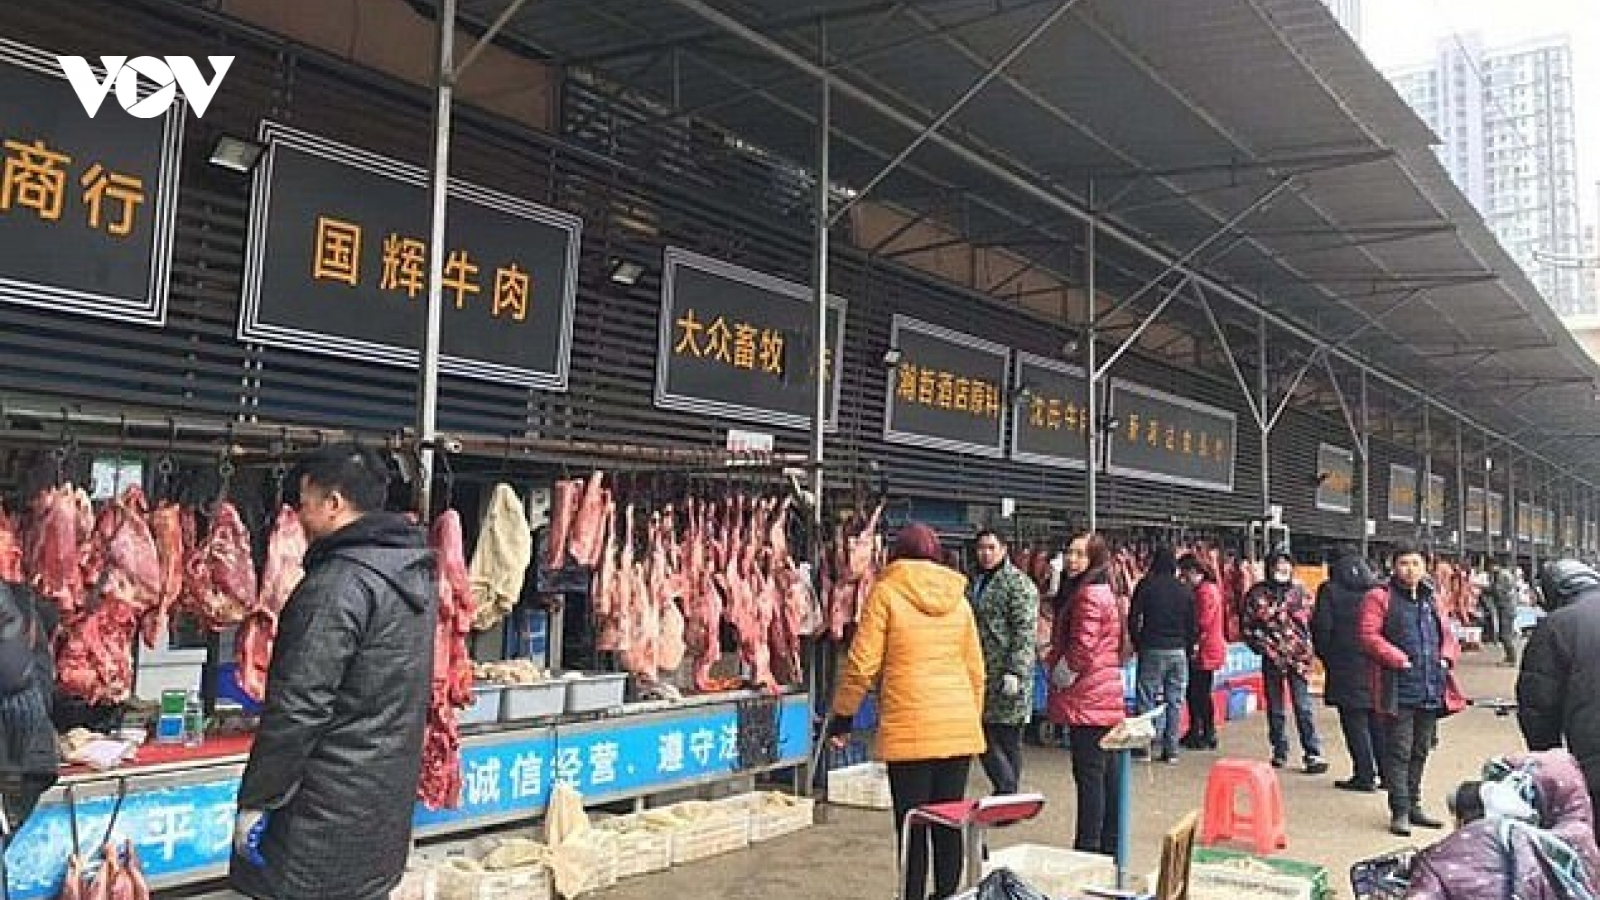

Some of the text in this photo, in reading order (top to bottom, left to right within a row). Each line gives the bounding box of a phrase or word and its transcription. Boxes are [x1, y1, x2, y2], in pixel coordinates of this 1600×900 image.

[0, 138, 145, 237] 商行
[312, 215, 531, 321] 国辉牛肉
[674, 308, 784, 376] 大众畜牧
